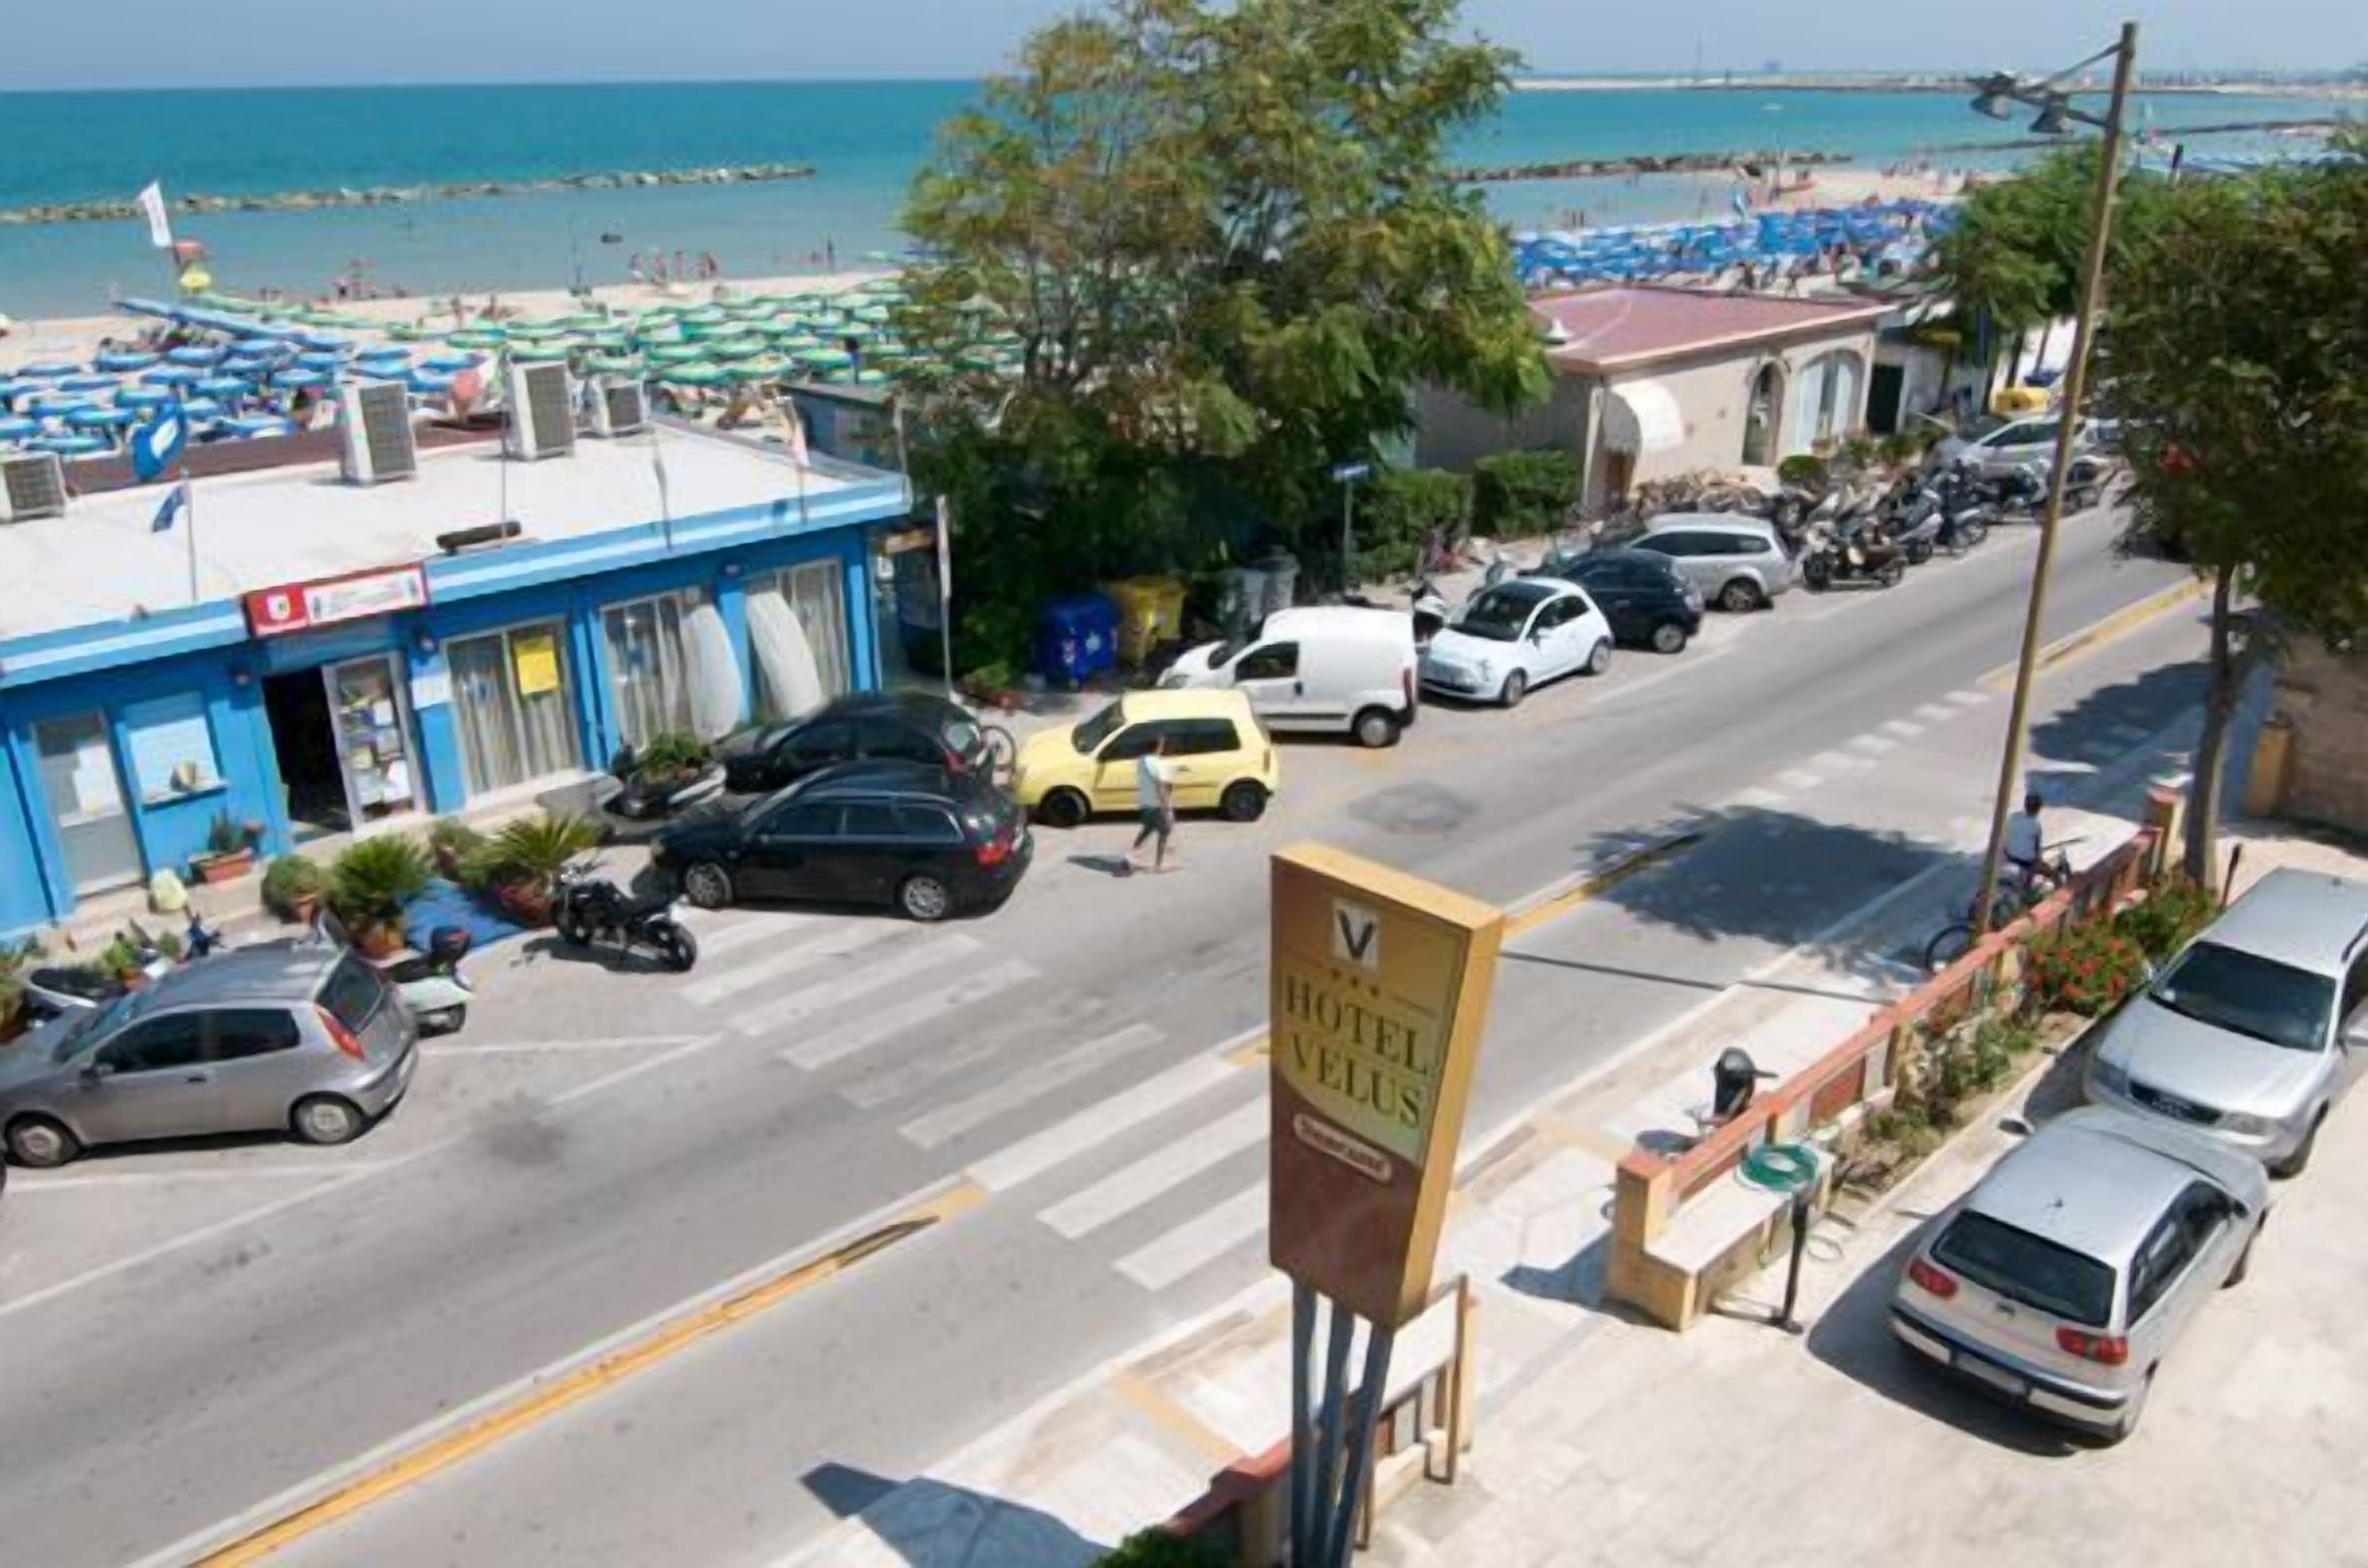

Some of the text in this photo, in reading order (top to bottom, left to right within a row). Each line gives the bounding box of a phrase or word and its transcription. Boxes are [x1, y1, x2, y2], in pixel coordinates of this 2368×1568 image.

[1337, 908, 1375, 960] V
[1286, 975, 1427, 1074] HOTEL
[1291, 1033, 1420, 1129] VELUS
